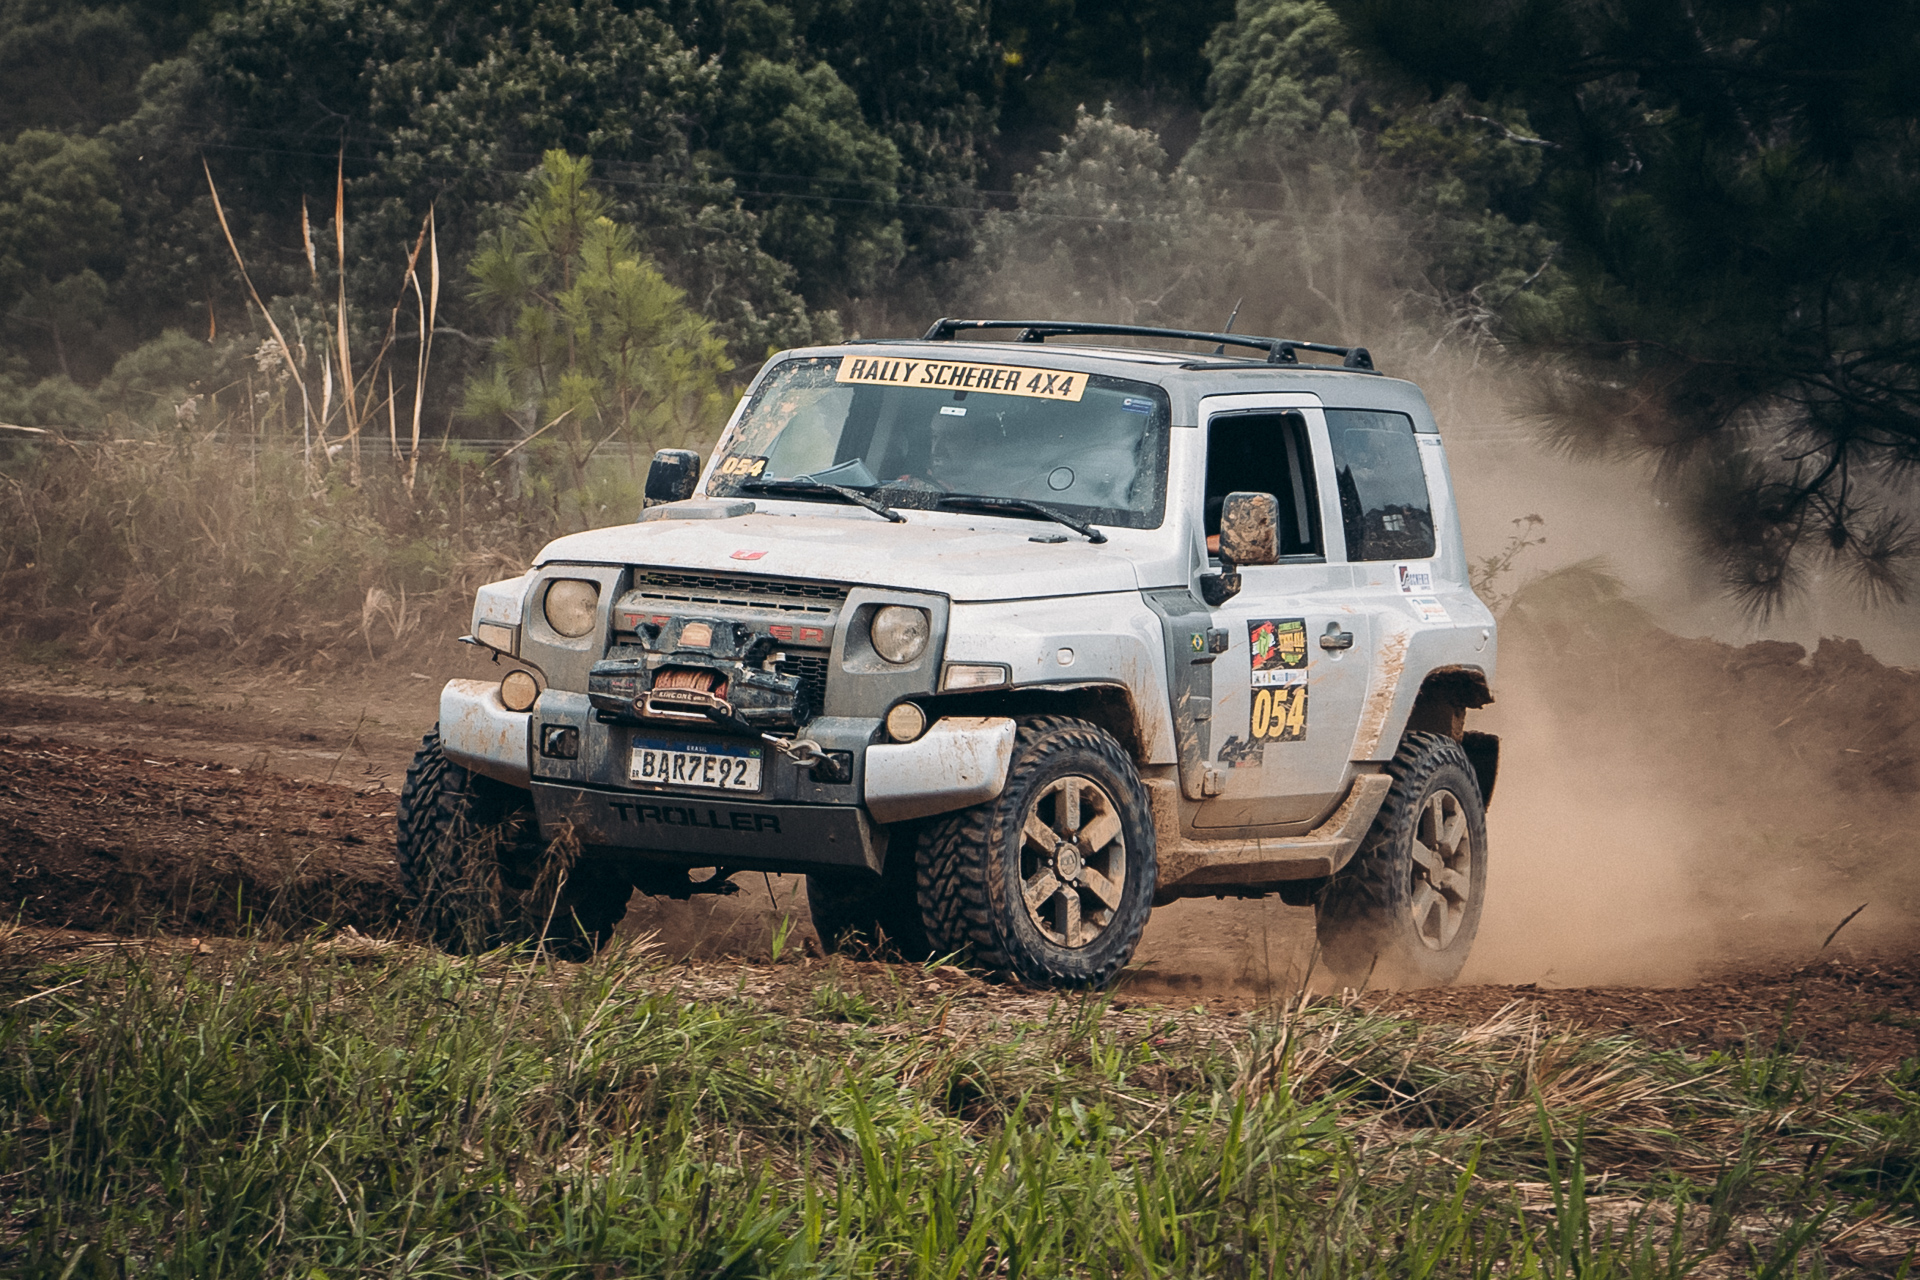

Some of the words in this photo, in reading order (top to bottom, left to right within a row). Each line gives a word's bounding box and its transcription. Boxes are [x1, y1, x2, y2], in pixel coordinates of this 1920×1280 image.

[849, 358, 919, 383] RALLY
[920, 363, 1022, 392] SCHERER
[1026, 373, 1075, 397] 4X4
[722, 456, 766, 477] 054
[1252, 688, 1305, 739] 054
[686, 745, 707, 753] BRASIL
[642, 751, 748, 786] BAR7E92
[609, 802, 782, 834] TROLLER
